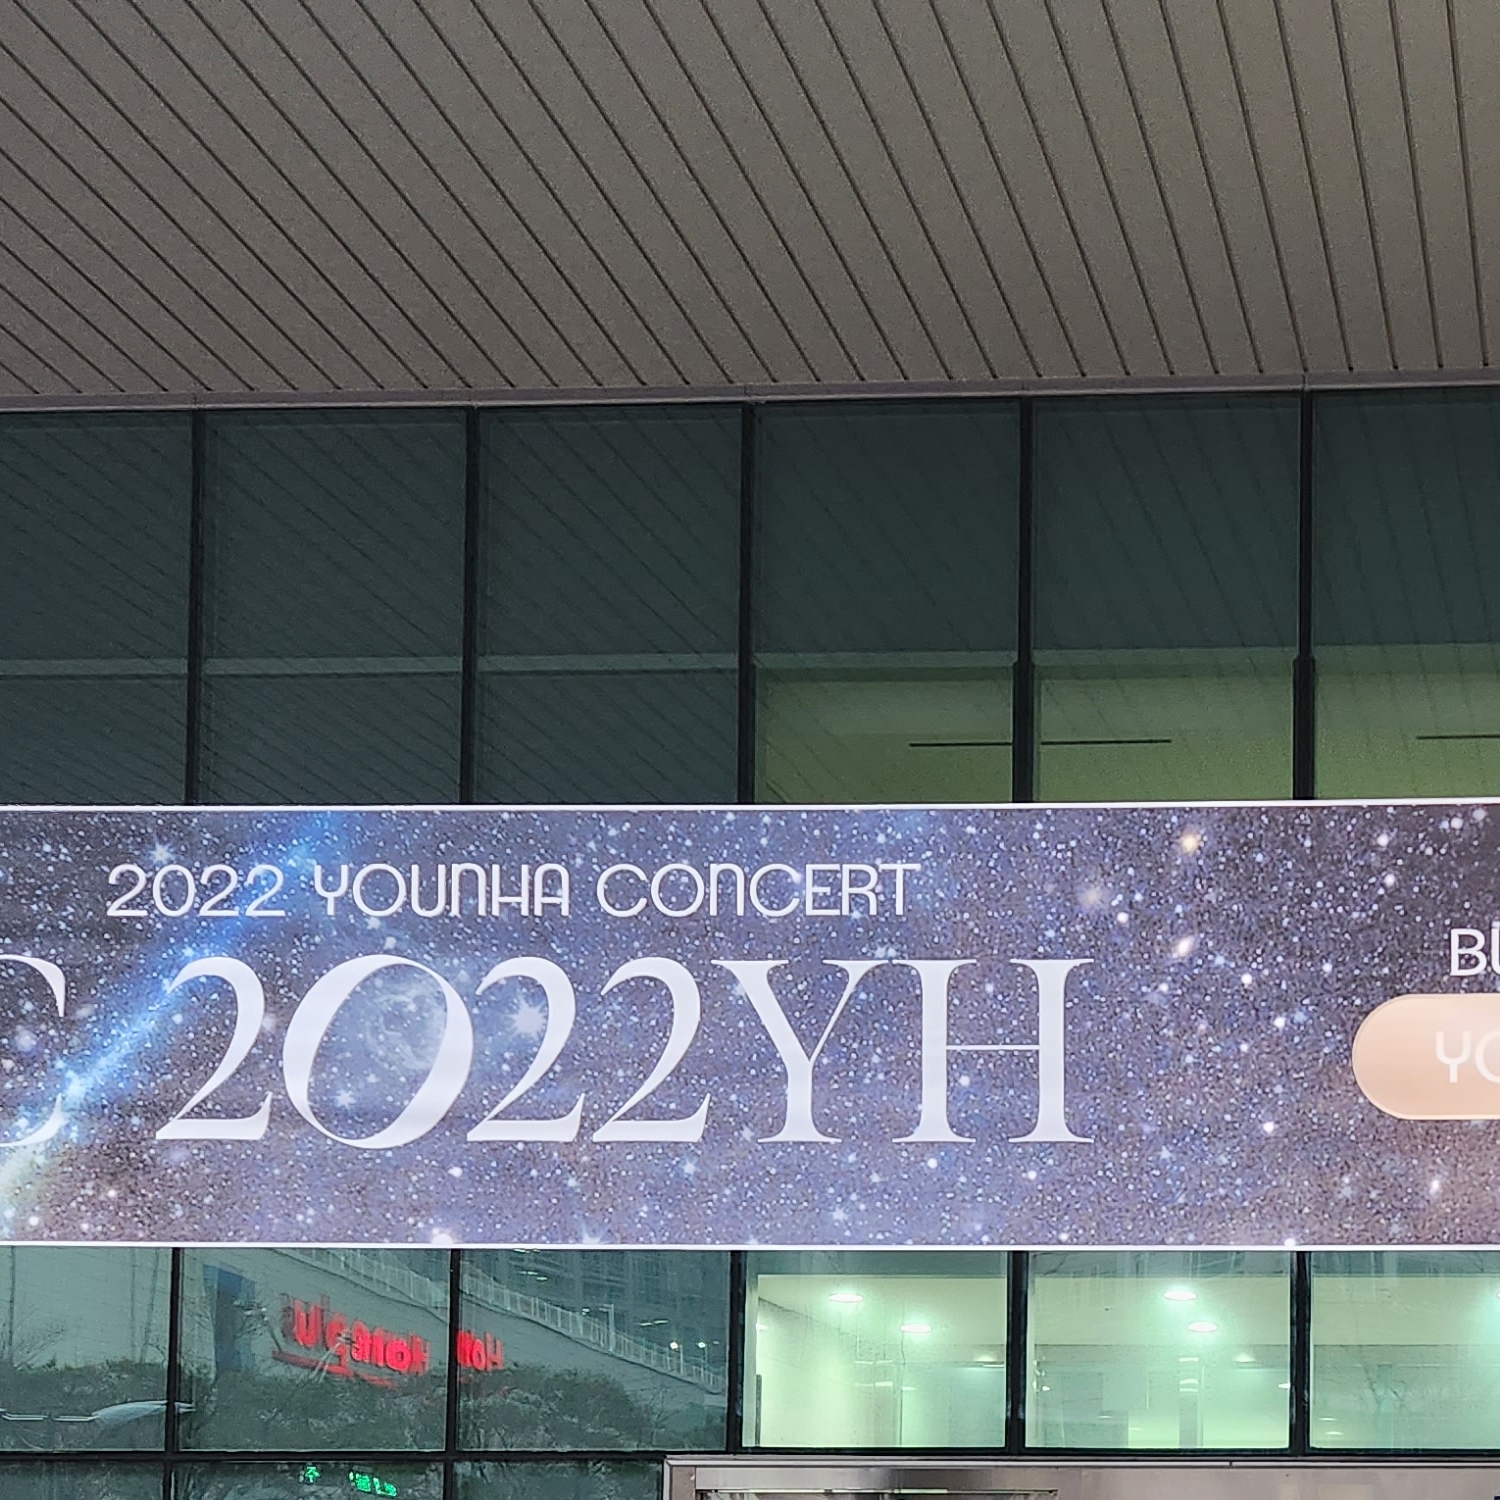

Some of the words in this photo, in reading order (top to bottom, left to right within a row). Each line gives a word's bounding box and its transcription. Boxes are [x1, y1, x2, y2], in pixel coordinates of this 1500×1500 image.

[106, 862, 286, 918] 2022
[312, 862, 571, 918] YOUNHA
[596, 860, 922, 918] CONCERT
